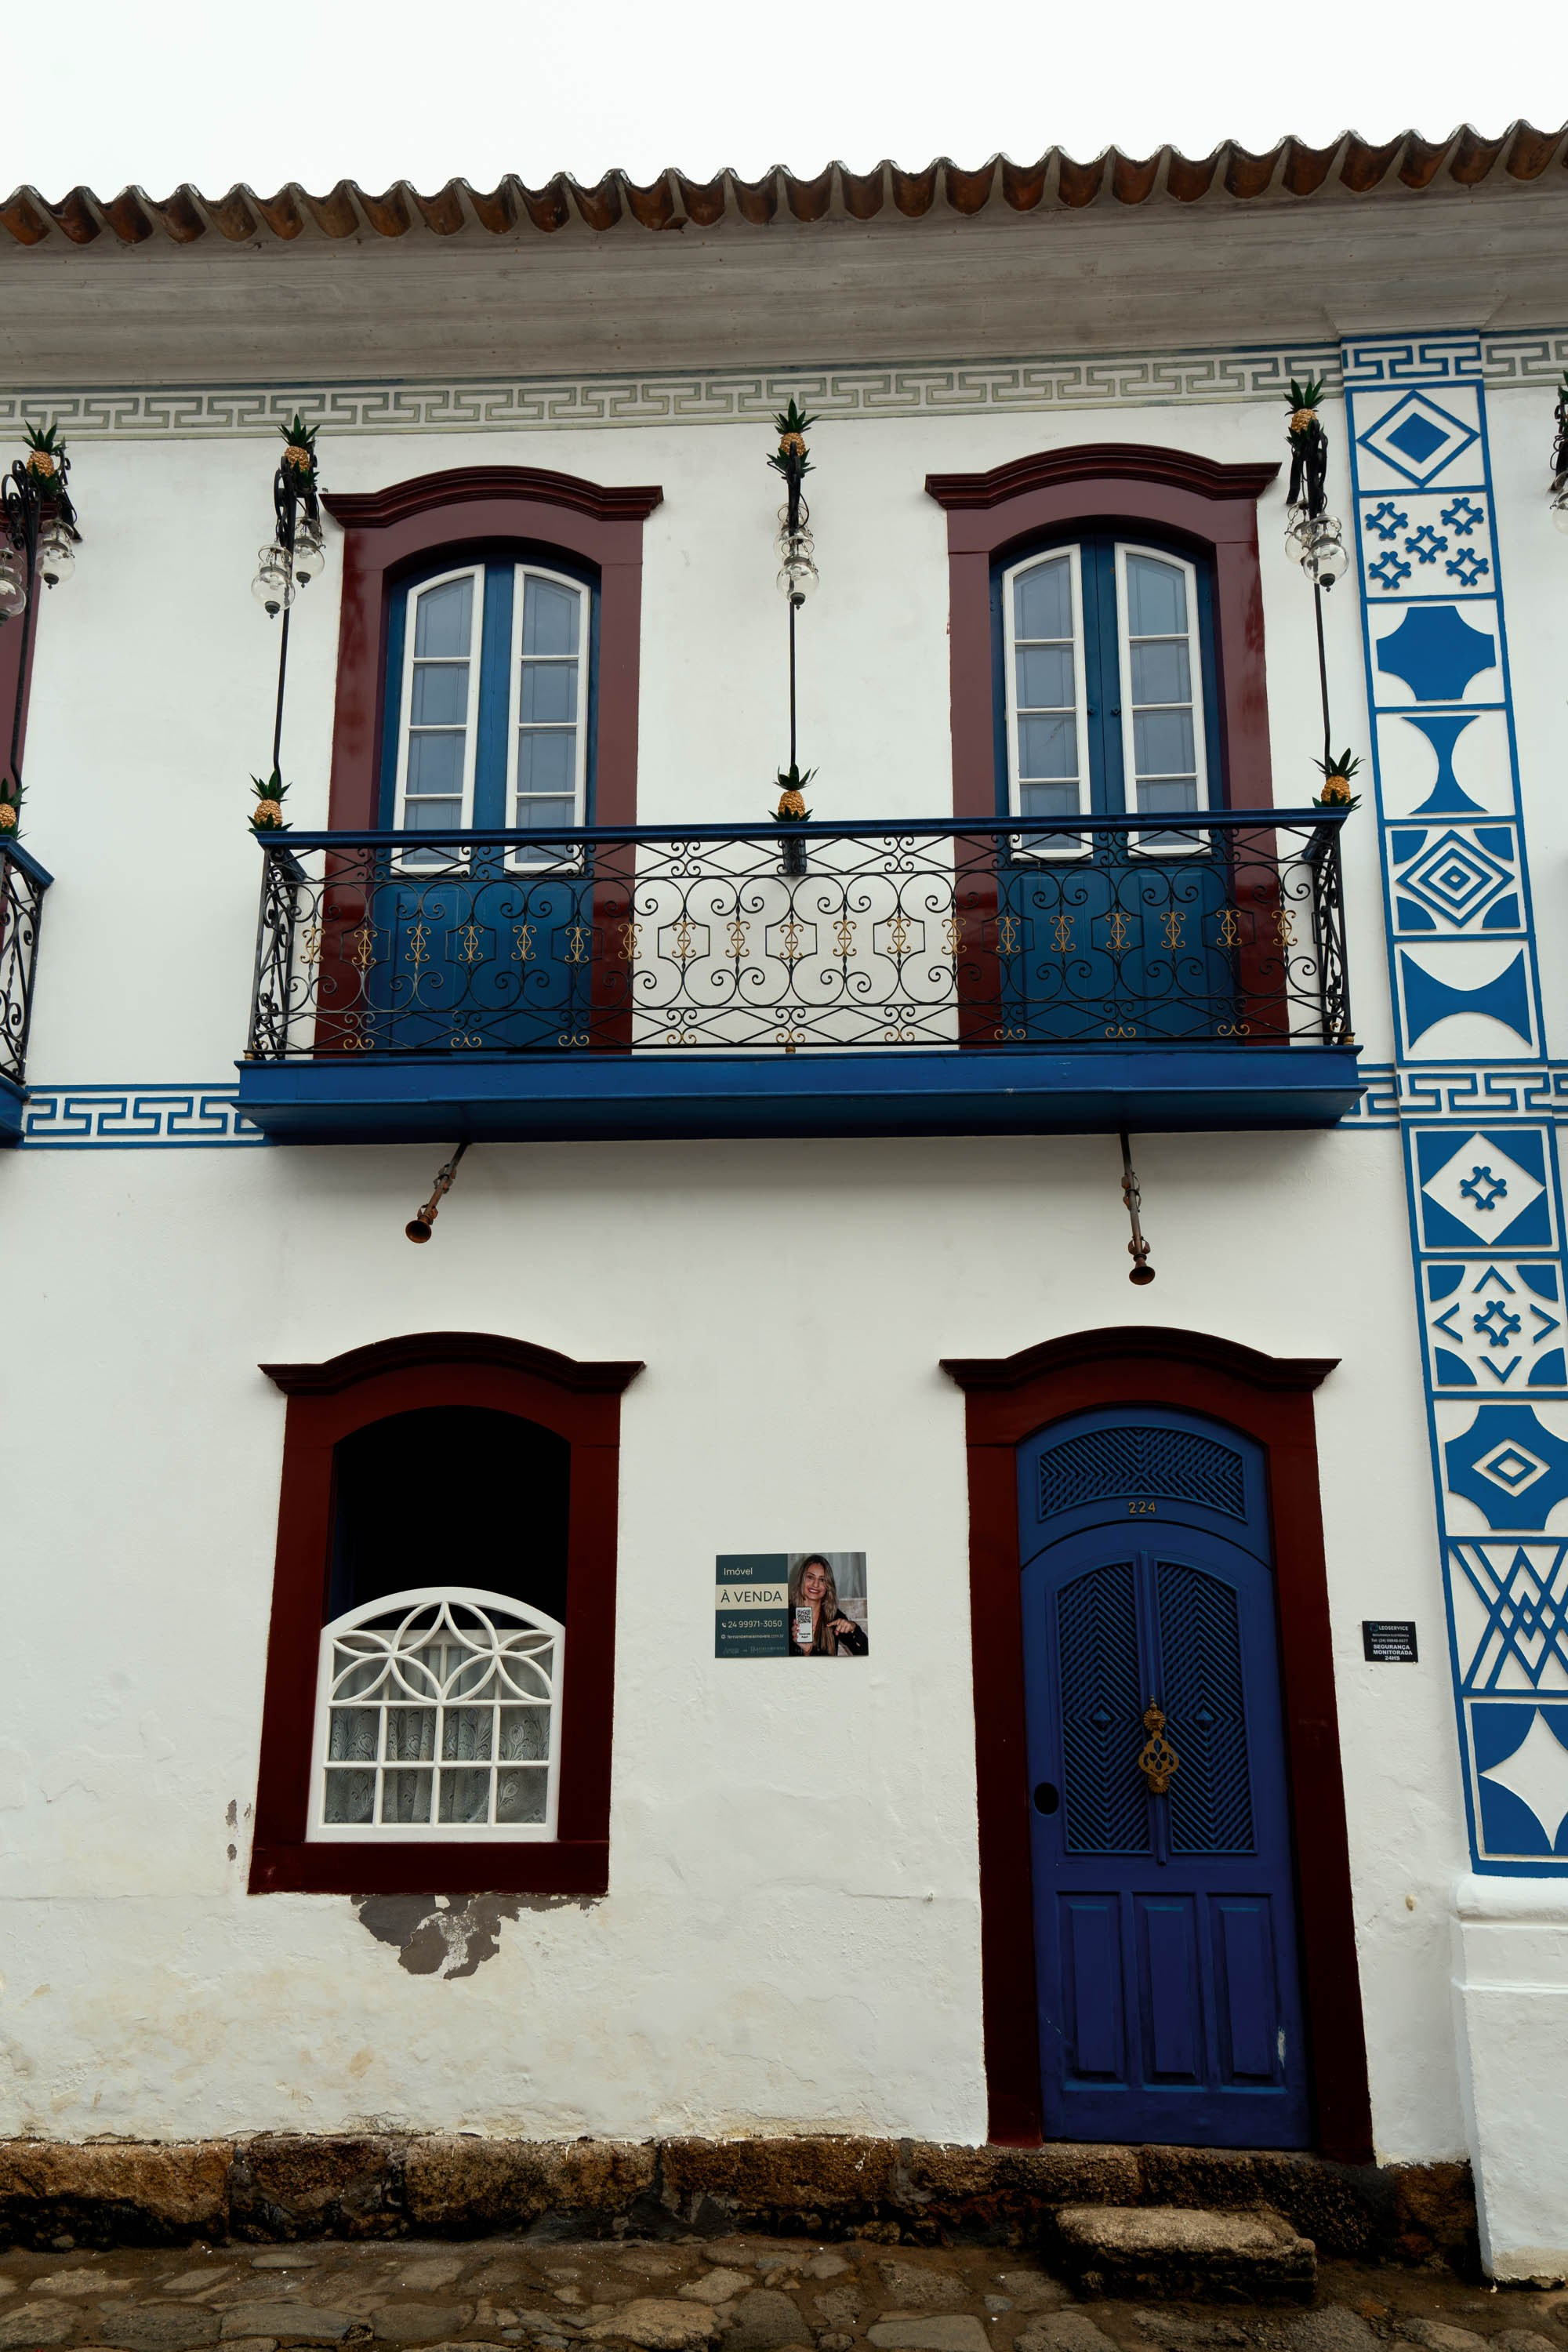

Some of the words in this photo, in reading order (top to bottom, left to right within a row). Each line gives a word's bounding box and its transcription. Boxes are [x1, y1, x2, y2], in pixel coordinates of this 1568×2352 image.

[1128, 1501, 1156, 1514] 224
[724, 1567, 753, 1576] Imóvel
[720, 1589, 730, 1602] À
[734, 1591, 782, 1602] VENDA
